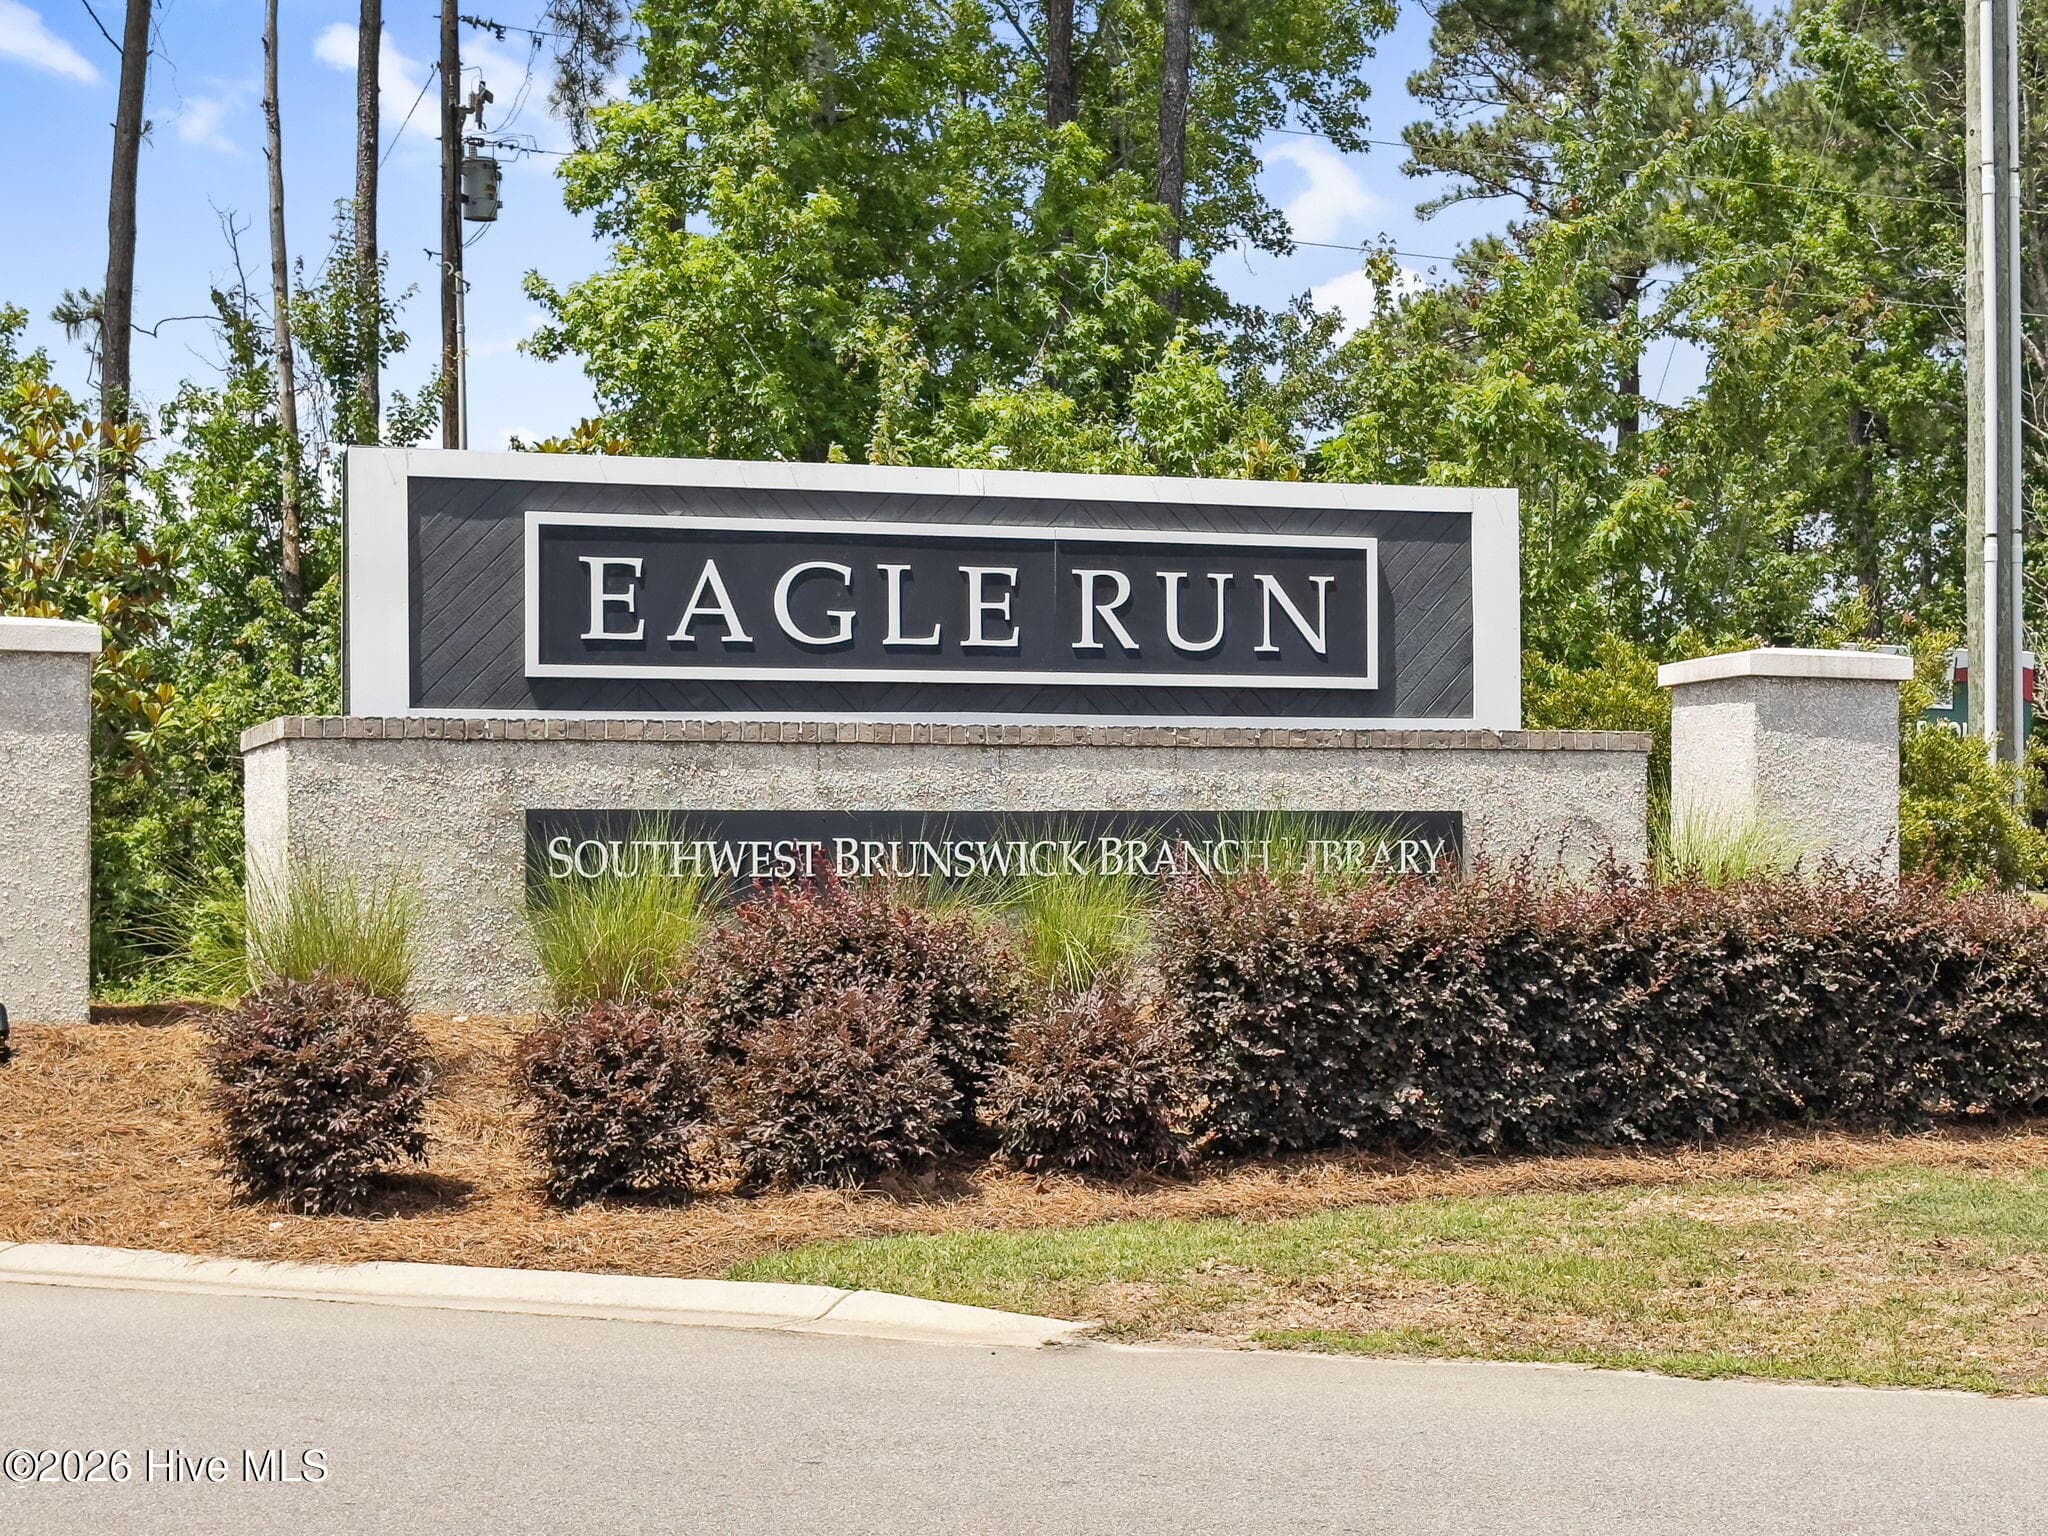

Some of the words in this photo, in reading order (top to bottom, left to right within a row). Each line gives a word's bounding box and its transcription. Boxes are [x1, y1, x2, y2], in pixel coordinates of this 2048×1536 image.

[577, 555, 1021, 648] EAGLE
[1071, 568, 1335, 655] RUN
[548, 836, 822, 879] SOUTHWEST
[832, 837, 1088, 879] BRUNSWICK
[1097, 836, 1272, 877] BRANCH
